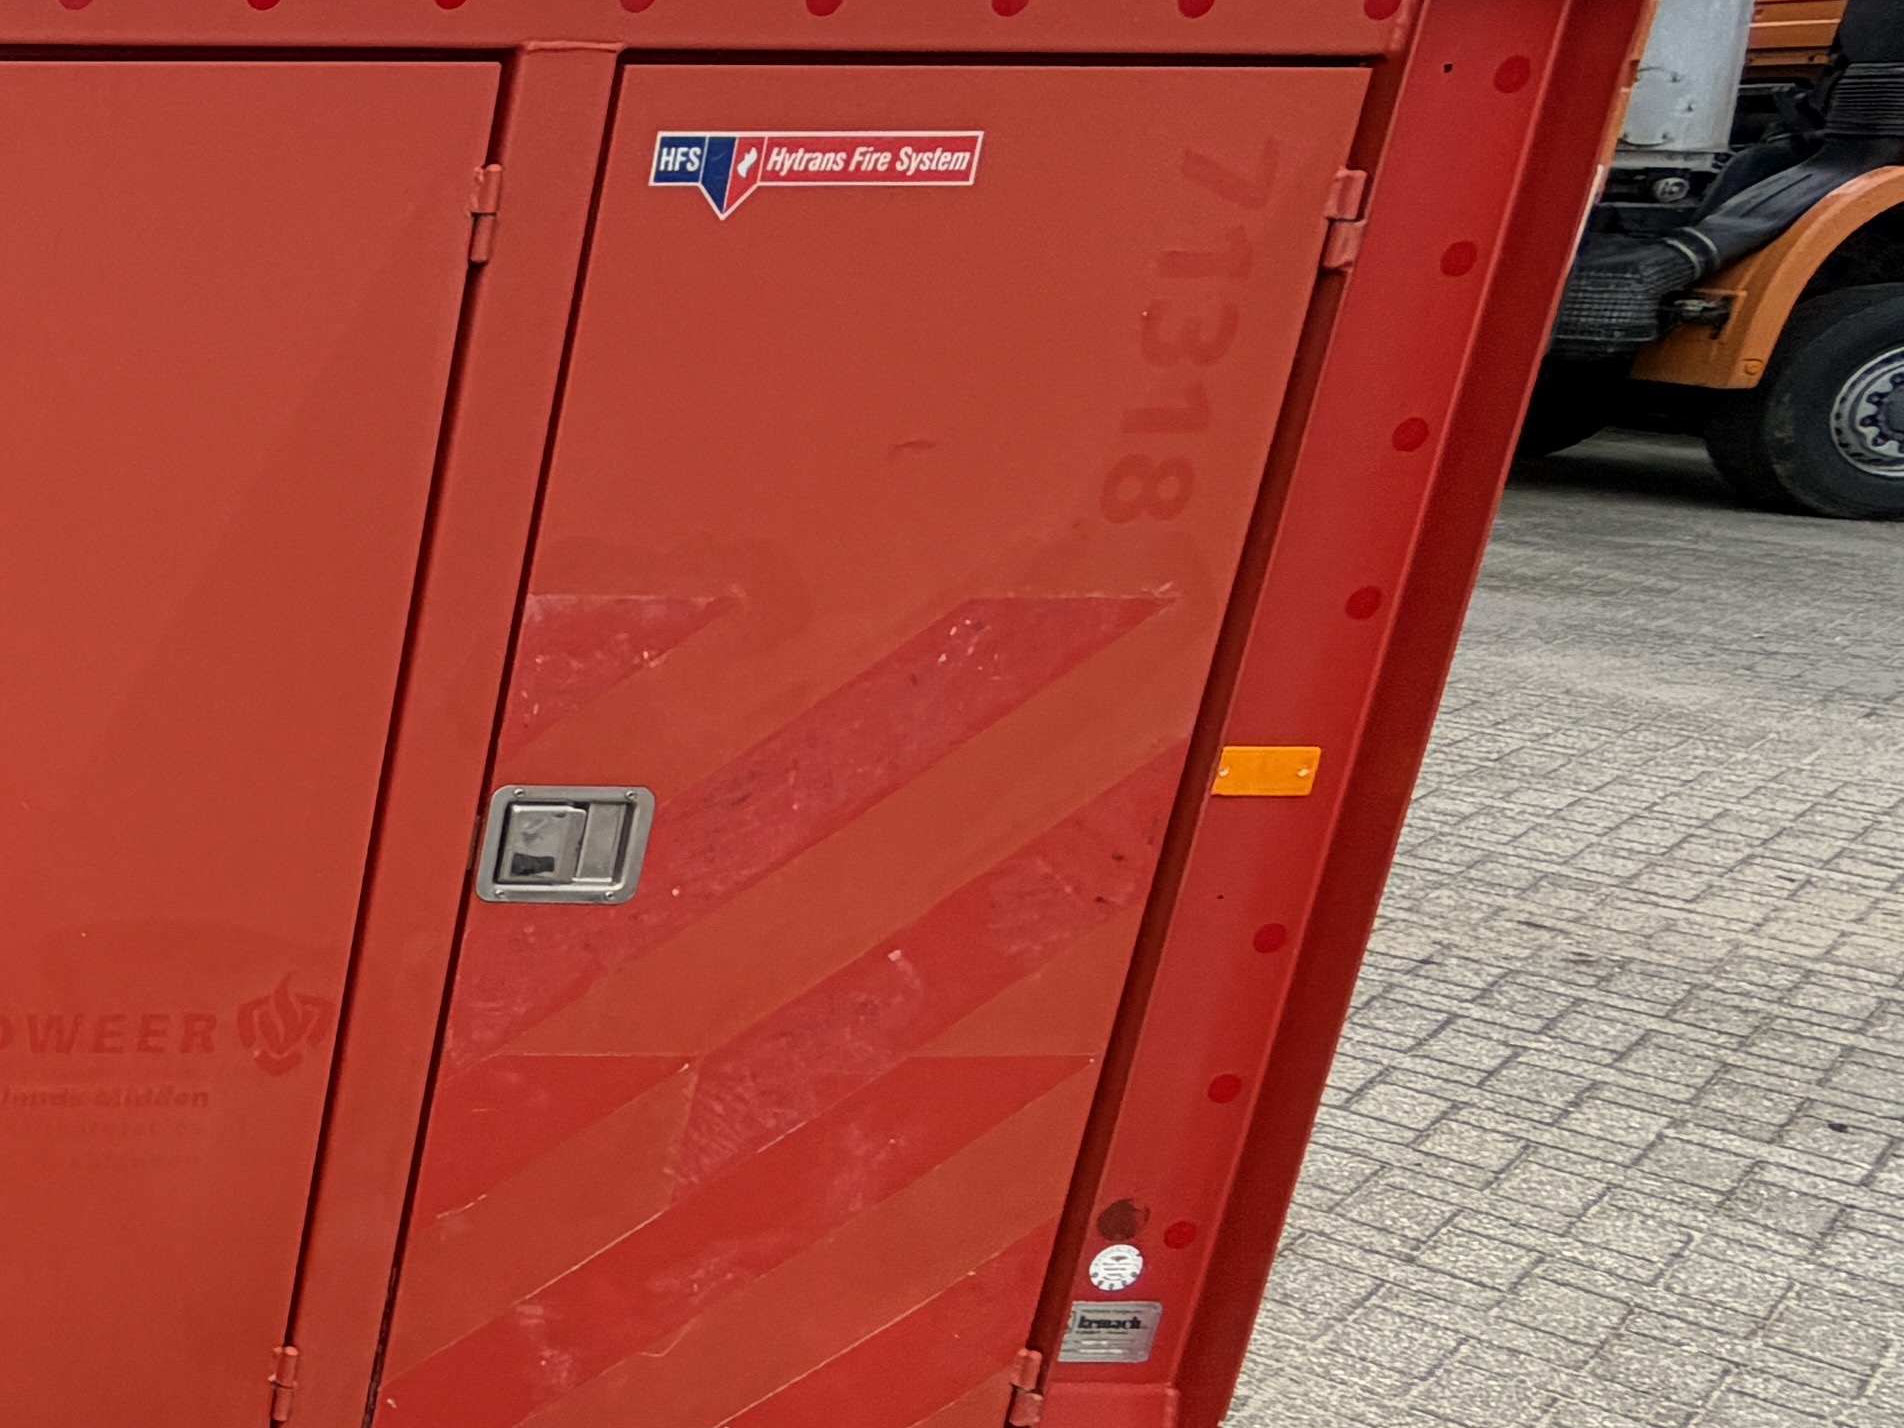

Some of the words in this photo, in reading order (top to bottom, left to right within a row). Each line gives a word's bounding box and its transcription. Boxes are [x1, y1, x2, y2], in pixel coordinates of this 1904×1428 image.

[659, 147, 703, 172] HFS
[766, 147, 846, 176] Hytrans
[848, 147, 890, 172] Fire
[895, 146, 972, 177] System
